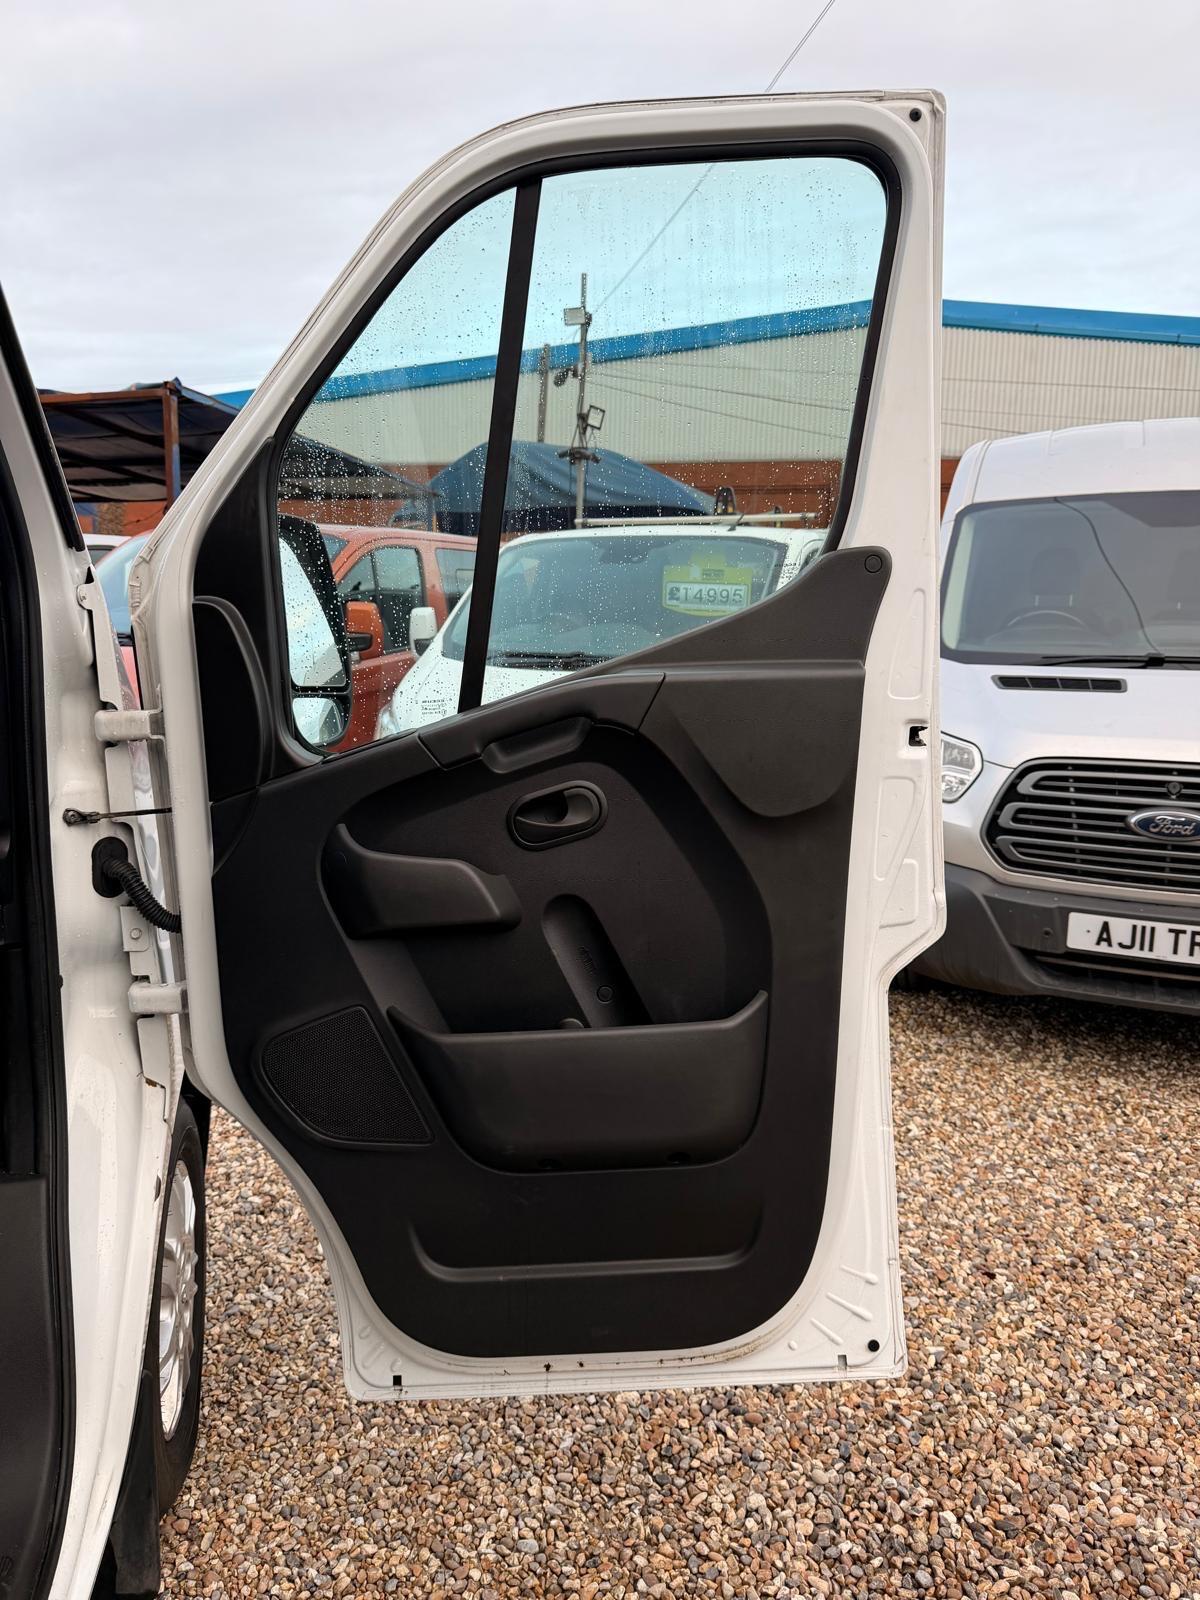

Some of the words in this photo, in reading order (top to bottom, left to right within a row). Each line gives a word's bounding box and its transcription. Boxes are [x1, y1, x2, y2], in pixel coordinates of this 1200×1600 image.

[667, 586, 744, 604] £14995
[1149, 815, 1195, 835] Ford
[1095, 920, 1156, 953] AJ11
